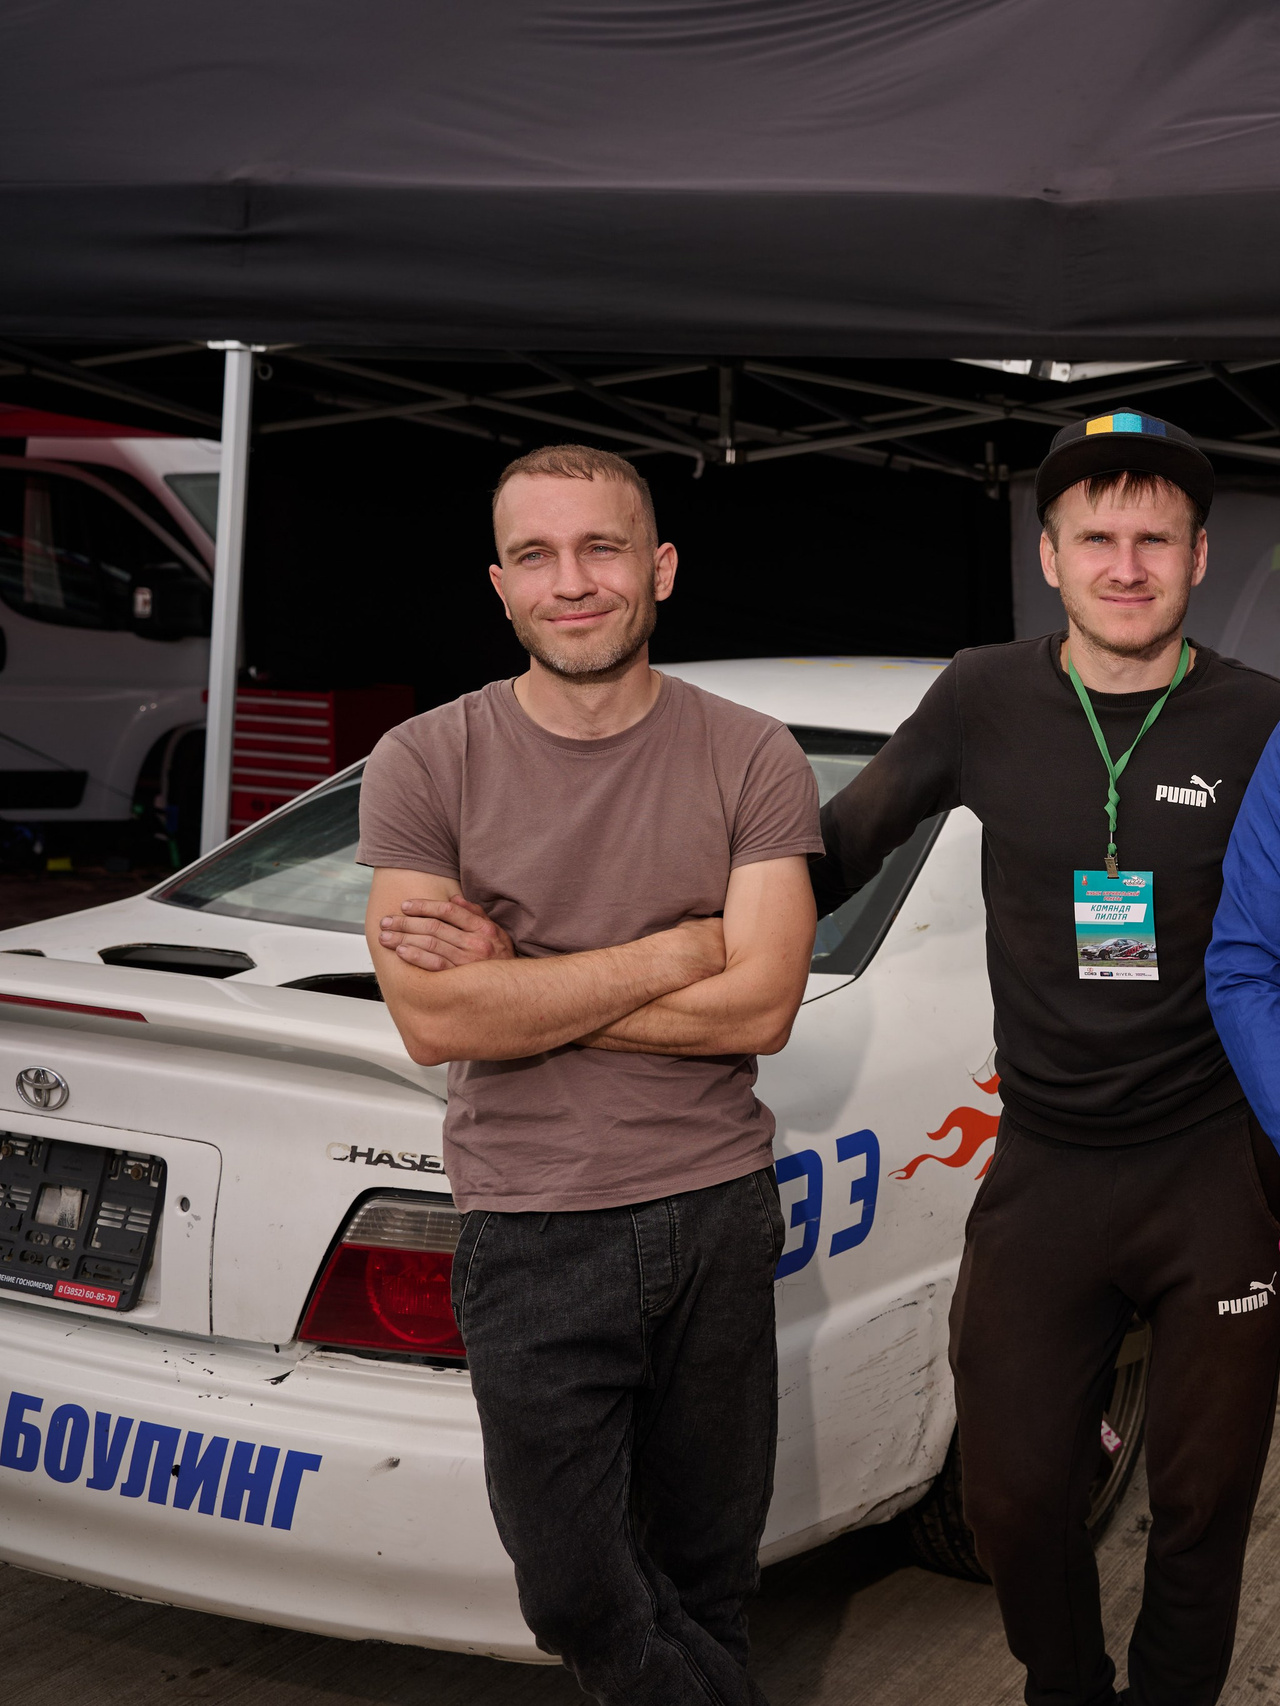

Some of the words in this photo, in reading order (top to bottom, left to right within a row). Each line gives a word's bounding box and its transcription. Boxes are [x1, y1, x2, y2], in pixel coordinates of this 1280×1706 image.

[1155, 784, 1208, 808] PUMA
[1090, 904, 1131, 913] КОМАНДА
[326, 1142, 447, 1175] CHASE
[16, 1277, 54, 1291] ГОСНОМЕРОВ
[58, 1285, 63, 1293] 8
[63, 1285, 85, 1298] (3852)
[85, 1290, 116, 1303] 60-85-70
[1218, 1291, 1268, 1315] PUMA
[0, 1391, 323, 1531] БОУЛИНГ
